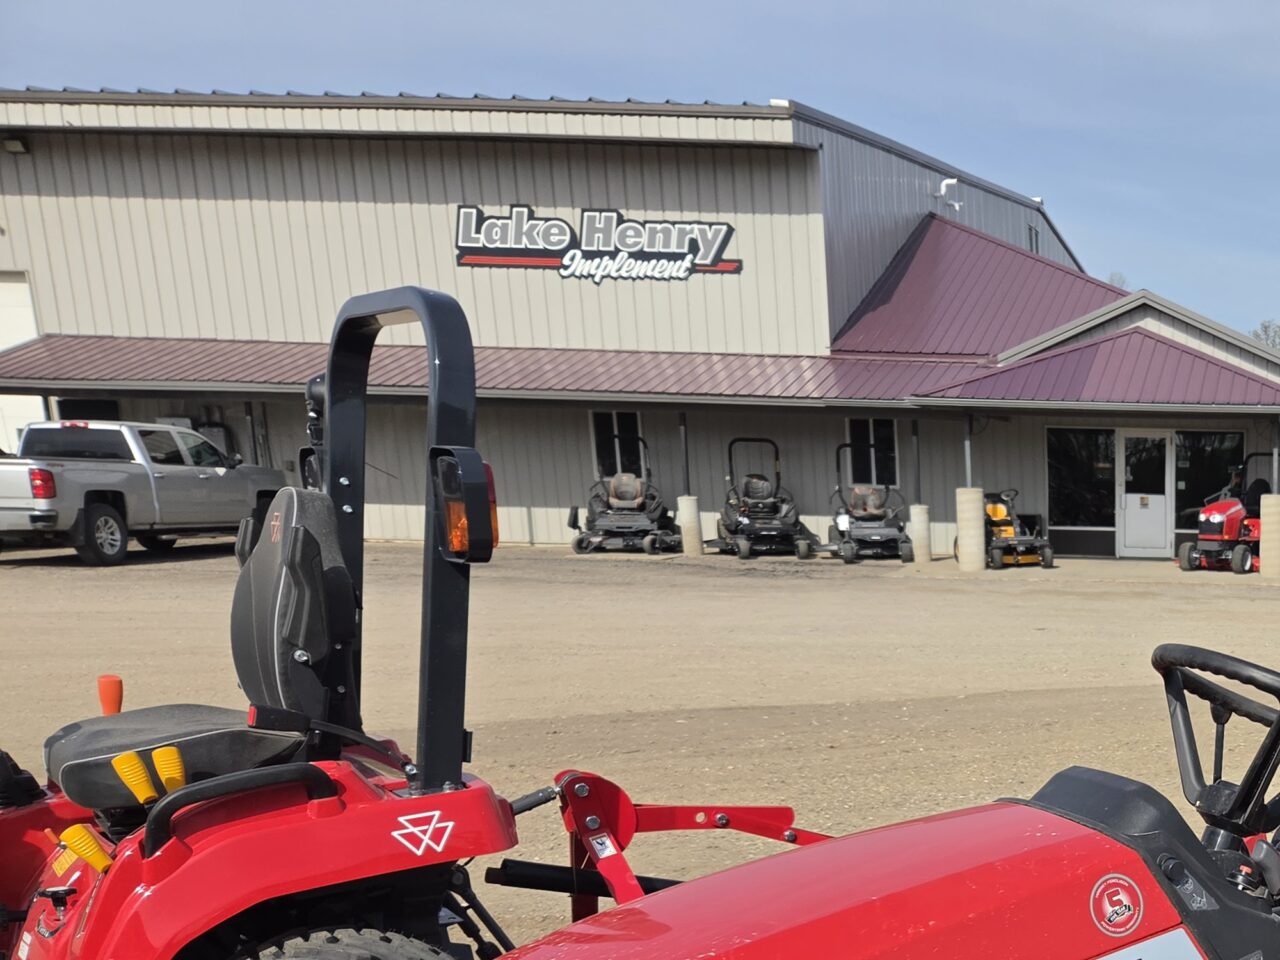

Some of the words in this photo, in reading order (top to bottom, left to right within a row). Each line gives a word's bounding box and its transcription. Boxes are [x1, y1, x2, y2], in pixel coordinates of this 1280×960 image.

[458, 206, 571, 250] Lake
[581, 211, 729, 266] Henry
[559, 250, 694, 283] Implement
